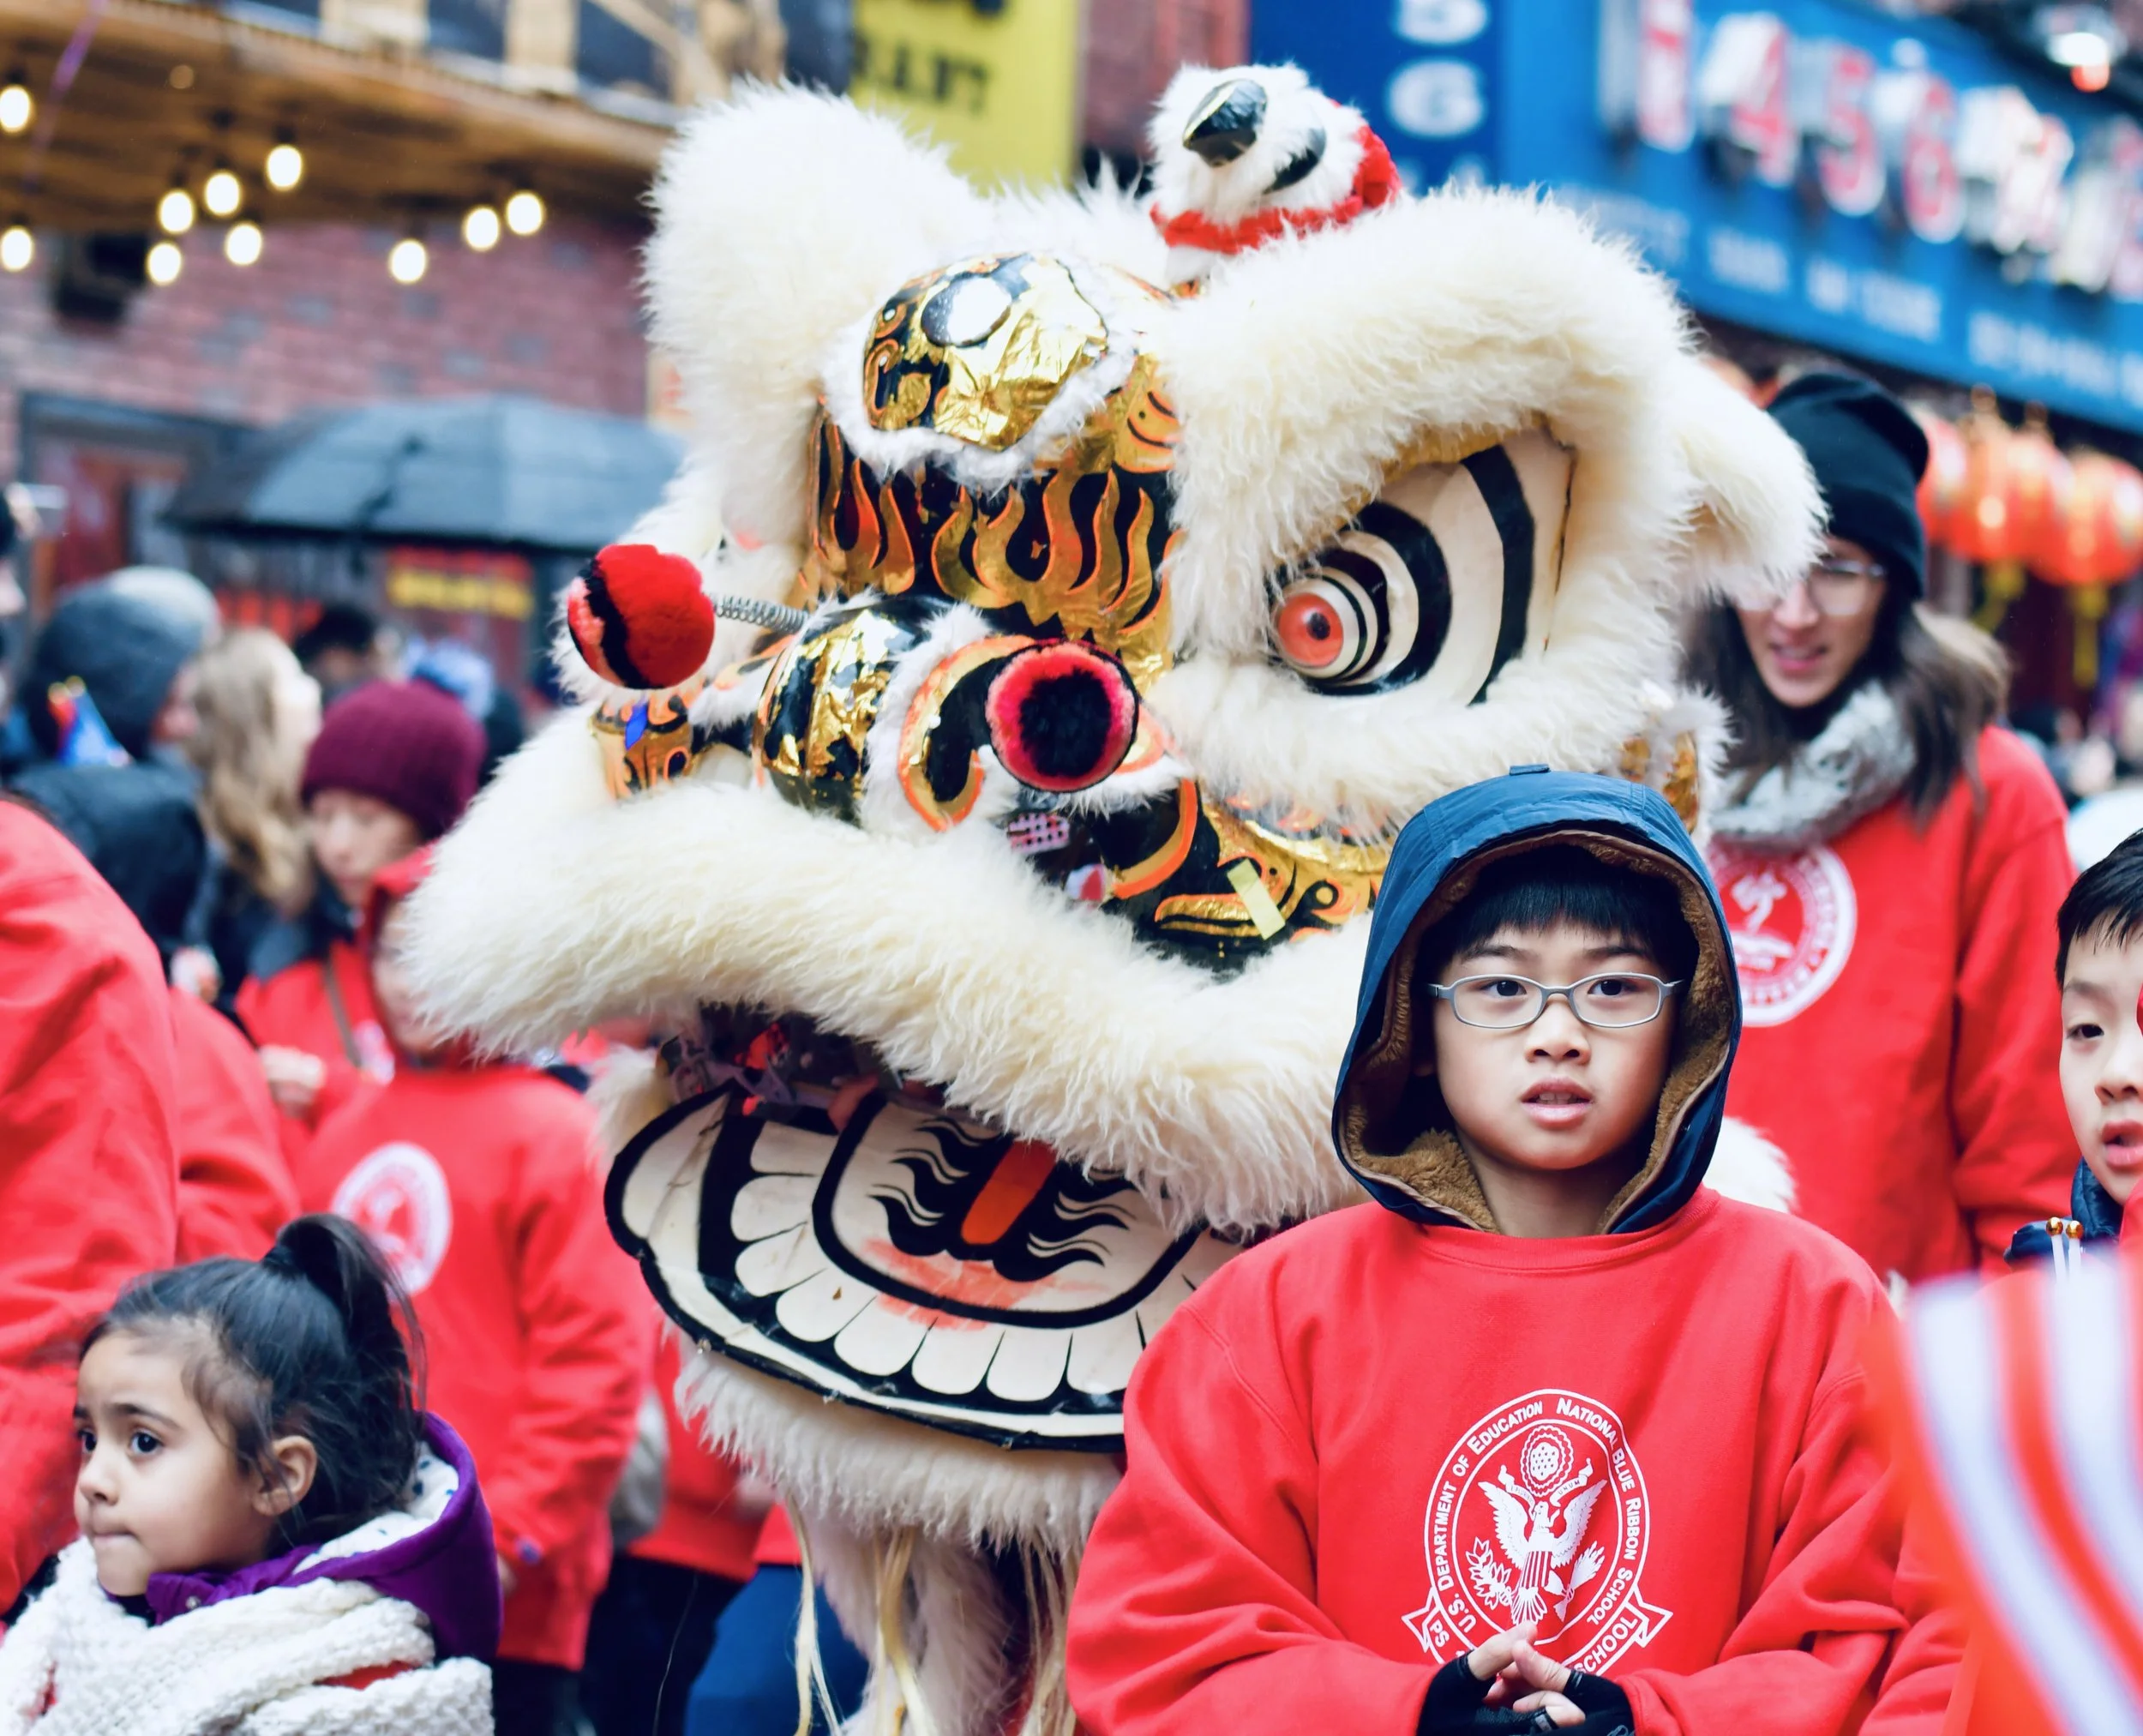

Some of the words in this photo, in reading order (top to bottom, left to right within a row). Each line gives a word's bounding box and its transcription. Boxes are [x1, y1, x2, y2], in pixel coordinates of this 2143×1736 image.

[1466, 1400, 1543, 1456] EDUCATION
[1556, 1397, 1619, 1451] NATIONAL
[1452, 1455, 1469, 1477] OF
[1612, 1447, 1636, 1493] BLUE
[1433, 1481, 1457, 1591] DEPARTMENT
[1623, 1496, 1642, 1560] RIBBON
[1448, 1593, 1477, 1633] U.S.
[1586, 1566, 1633, 1625] SCHOOL
[1429, 1619, 1450, 1648] PS
